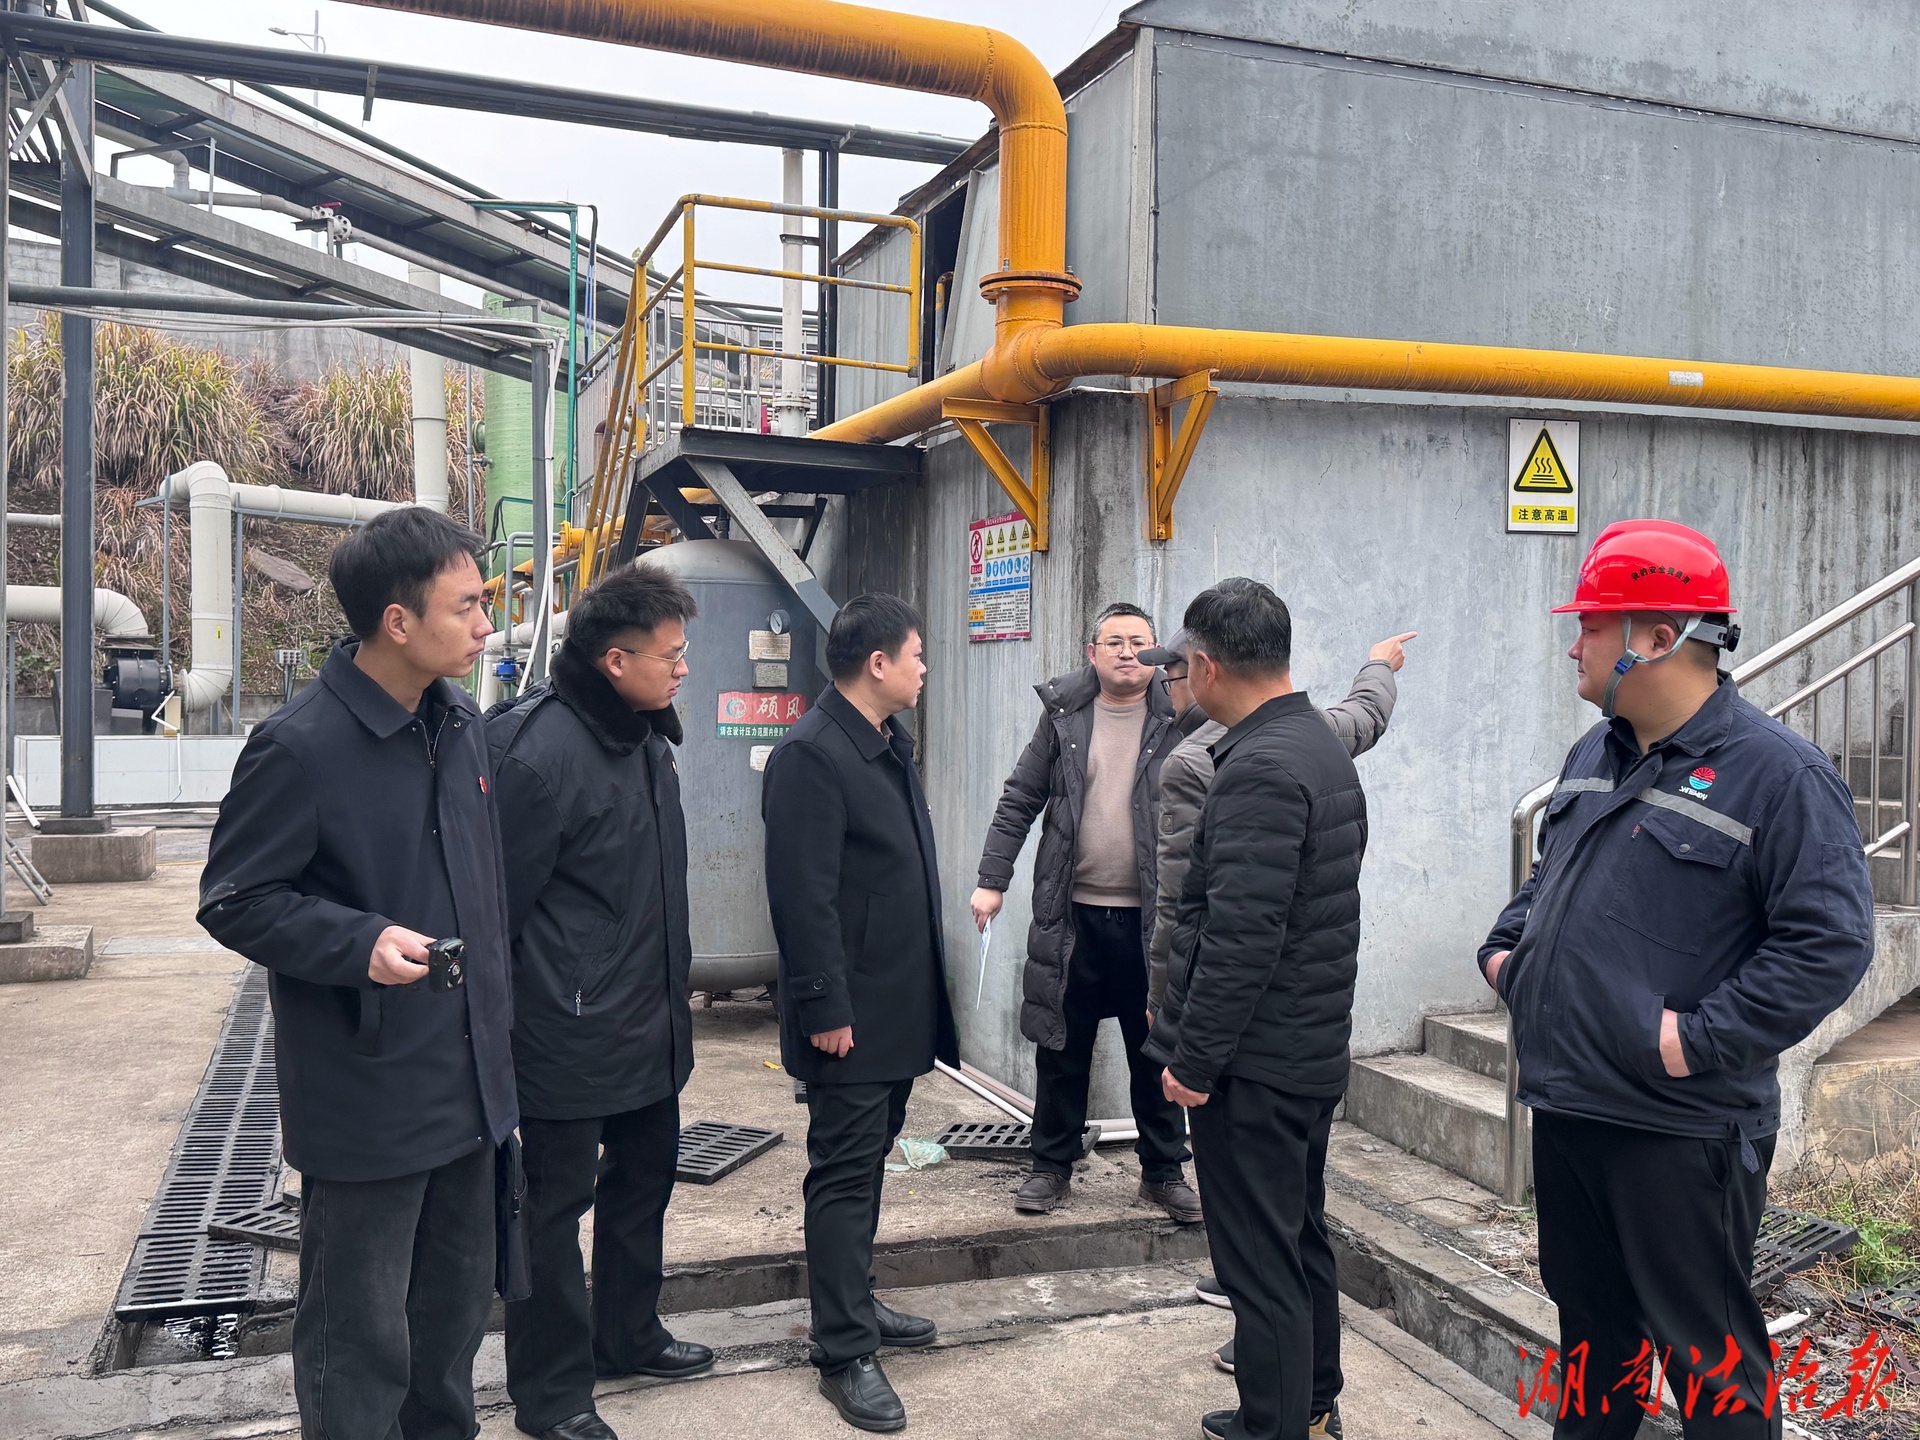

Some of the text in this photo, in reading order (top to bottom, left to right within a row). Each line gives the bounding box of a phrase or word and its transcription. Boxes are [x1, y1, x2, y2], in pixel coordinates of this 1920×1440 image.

[1518, 508, 1568, 521] 注意高温
[756, 695, 802, 720] 硕风
